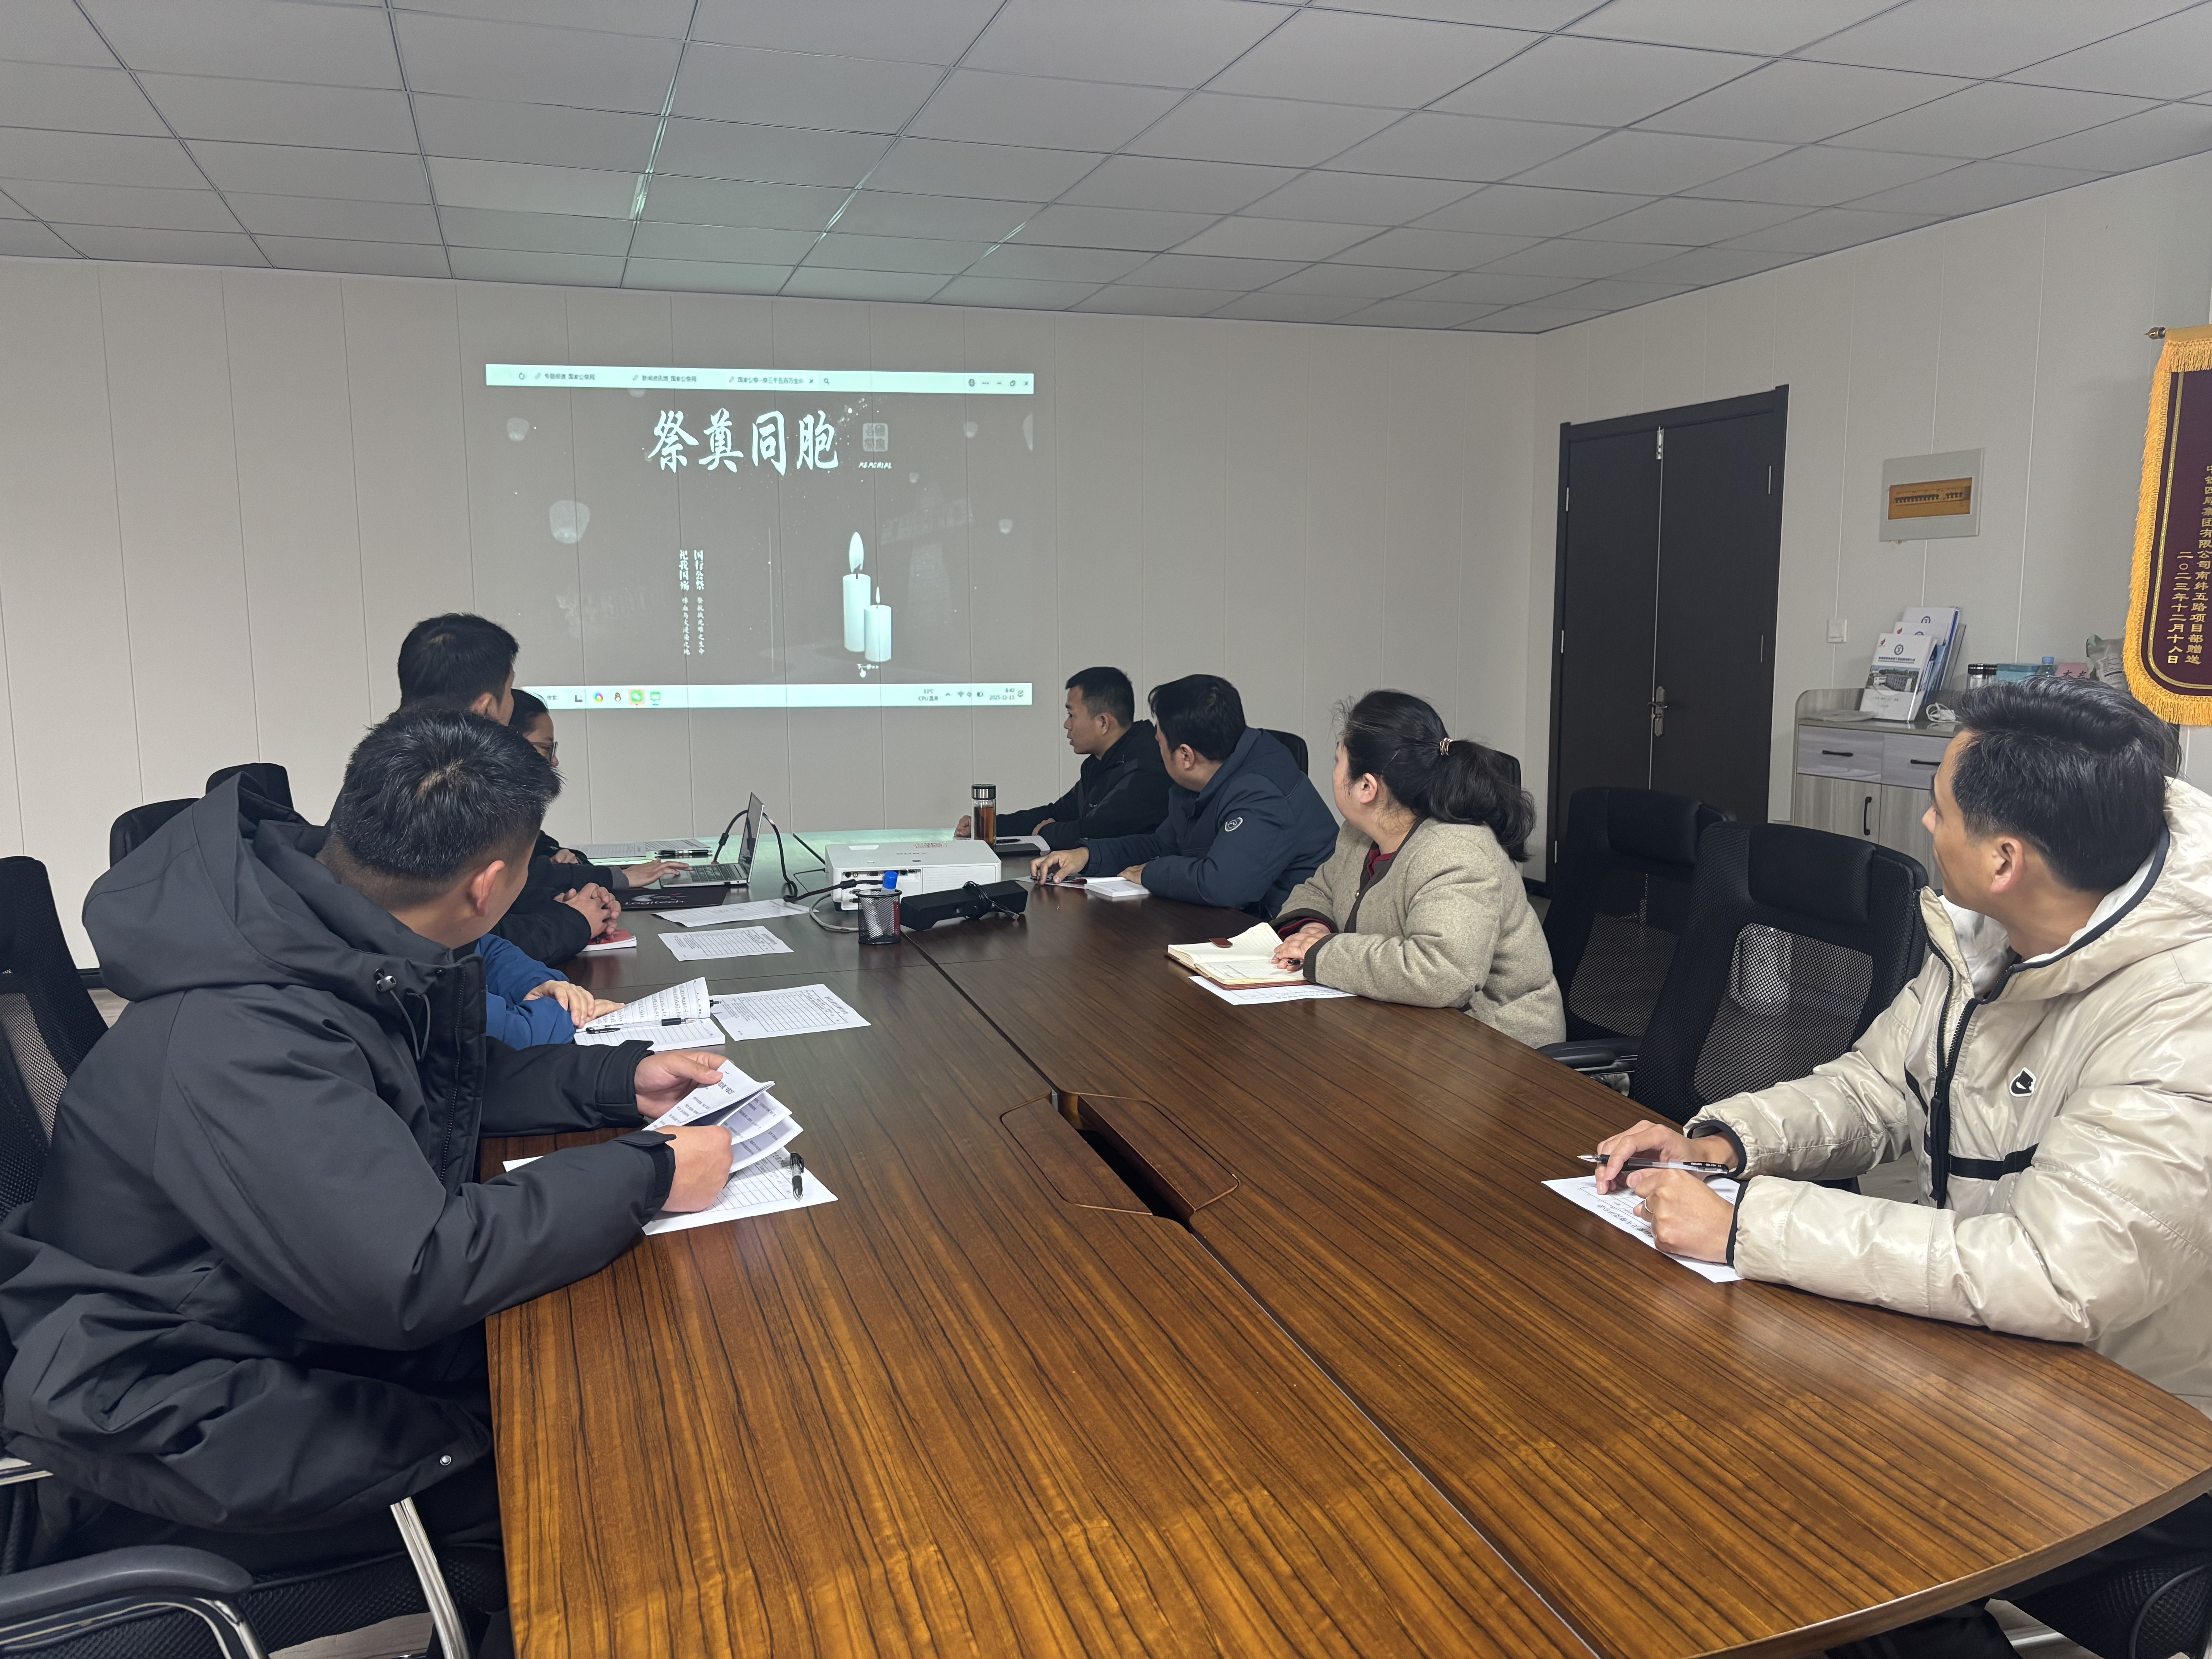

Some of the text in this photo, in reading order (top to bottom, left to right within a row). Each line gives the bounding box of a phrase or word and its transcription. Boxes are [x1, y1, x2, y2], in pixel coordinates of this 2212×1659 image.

[648, 408, 839, 476] 祭奠同胞
[2167, 551, 2194, 665] 二〇二三年十二月十八日
